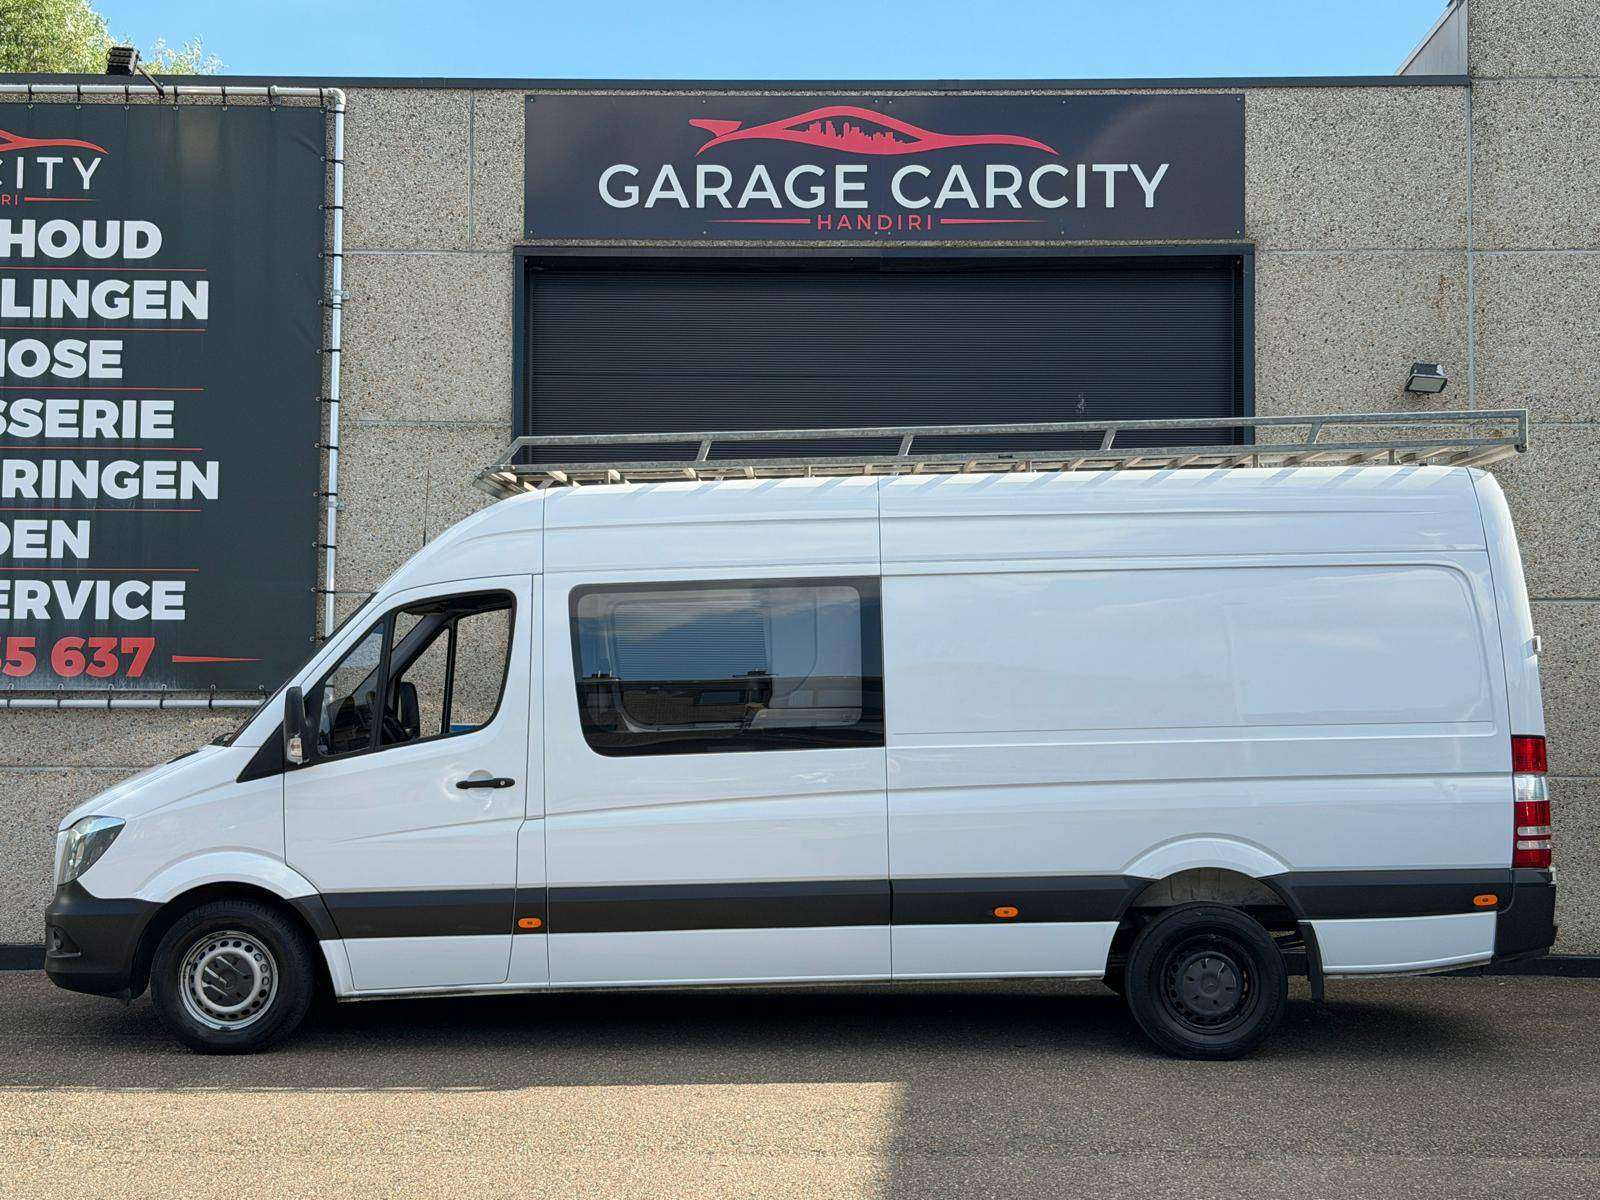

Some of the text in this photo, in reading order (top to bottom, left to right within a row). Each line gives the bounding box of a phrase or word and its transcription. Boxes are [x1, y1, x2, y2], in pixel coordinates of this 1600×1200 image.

[0, 156, 102, 190] ITY
[598, 163, 1169, 209] GARAGE CARCITY
[1, 194, 18, 206] RI
[0, 218, 163, 259] HOUD
[817, 214, 932, 231] HANDIRI
[1, 278, 209, 320] LINGEN
[0, 338, 123, 379] OSE
[0, 398, 175, 439] SERIE
[2, 459, 219, 500] RINGEN
[51, 636, 156, 677] 637
